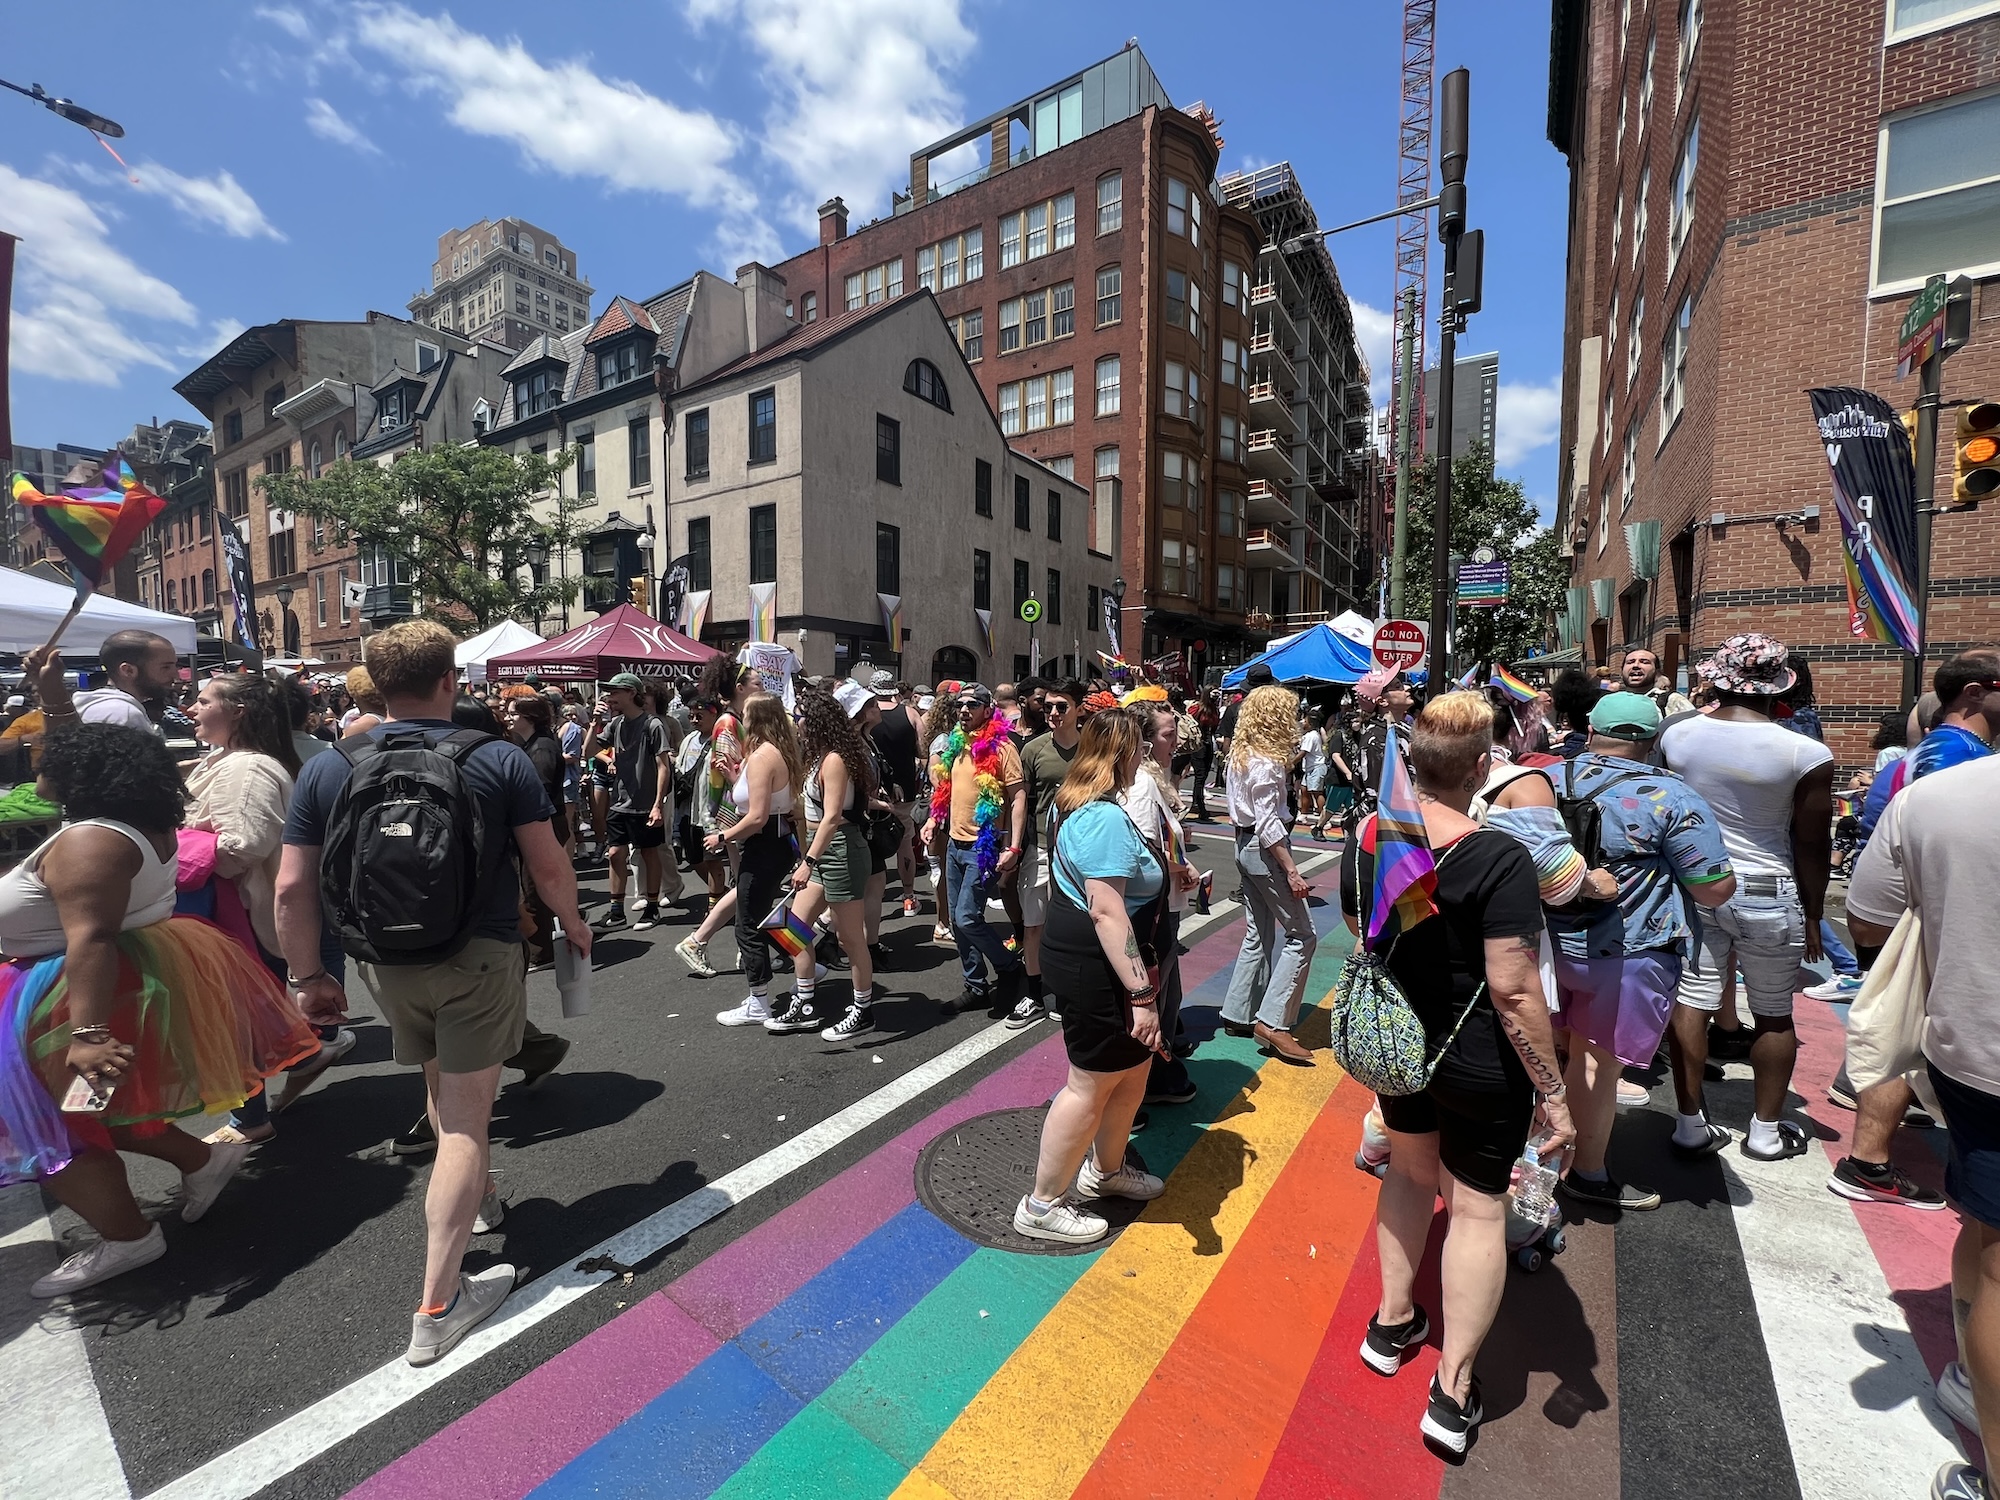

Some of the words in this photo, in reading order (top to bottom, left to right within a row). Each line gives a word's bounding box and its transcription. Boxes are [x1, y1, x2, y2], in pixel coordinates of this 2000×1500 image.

[1932, 287, 1945, 313] St
[1381, 629, 1396, 639] DO
[1398, 630, 1420, 640] NOT
[755, 652, 786, 671] GAY
[1382, 652, 1413, 662] ENTER
[620, 662, 689, 677] MAZZONI
[761, 680, 785, 695] RIDE
